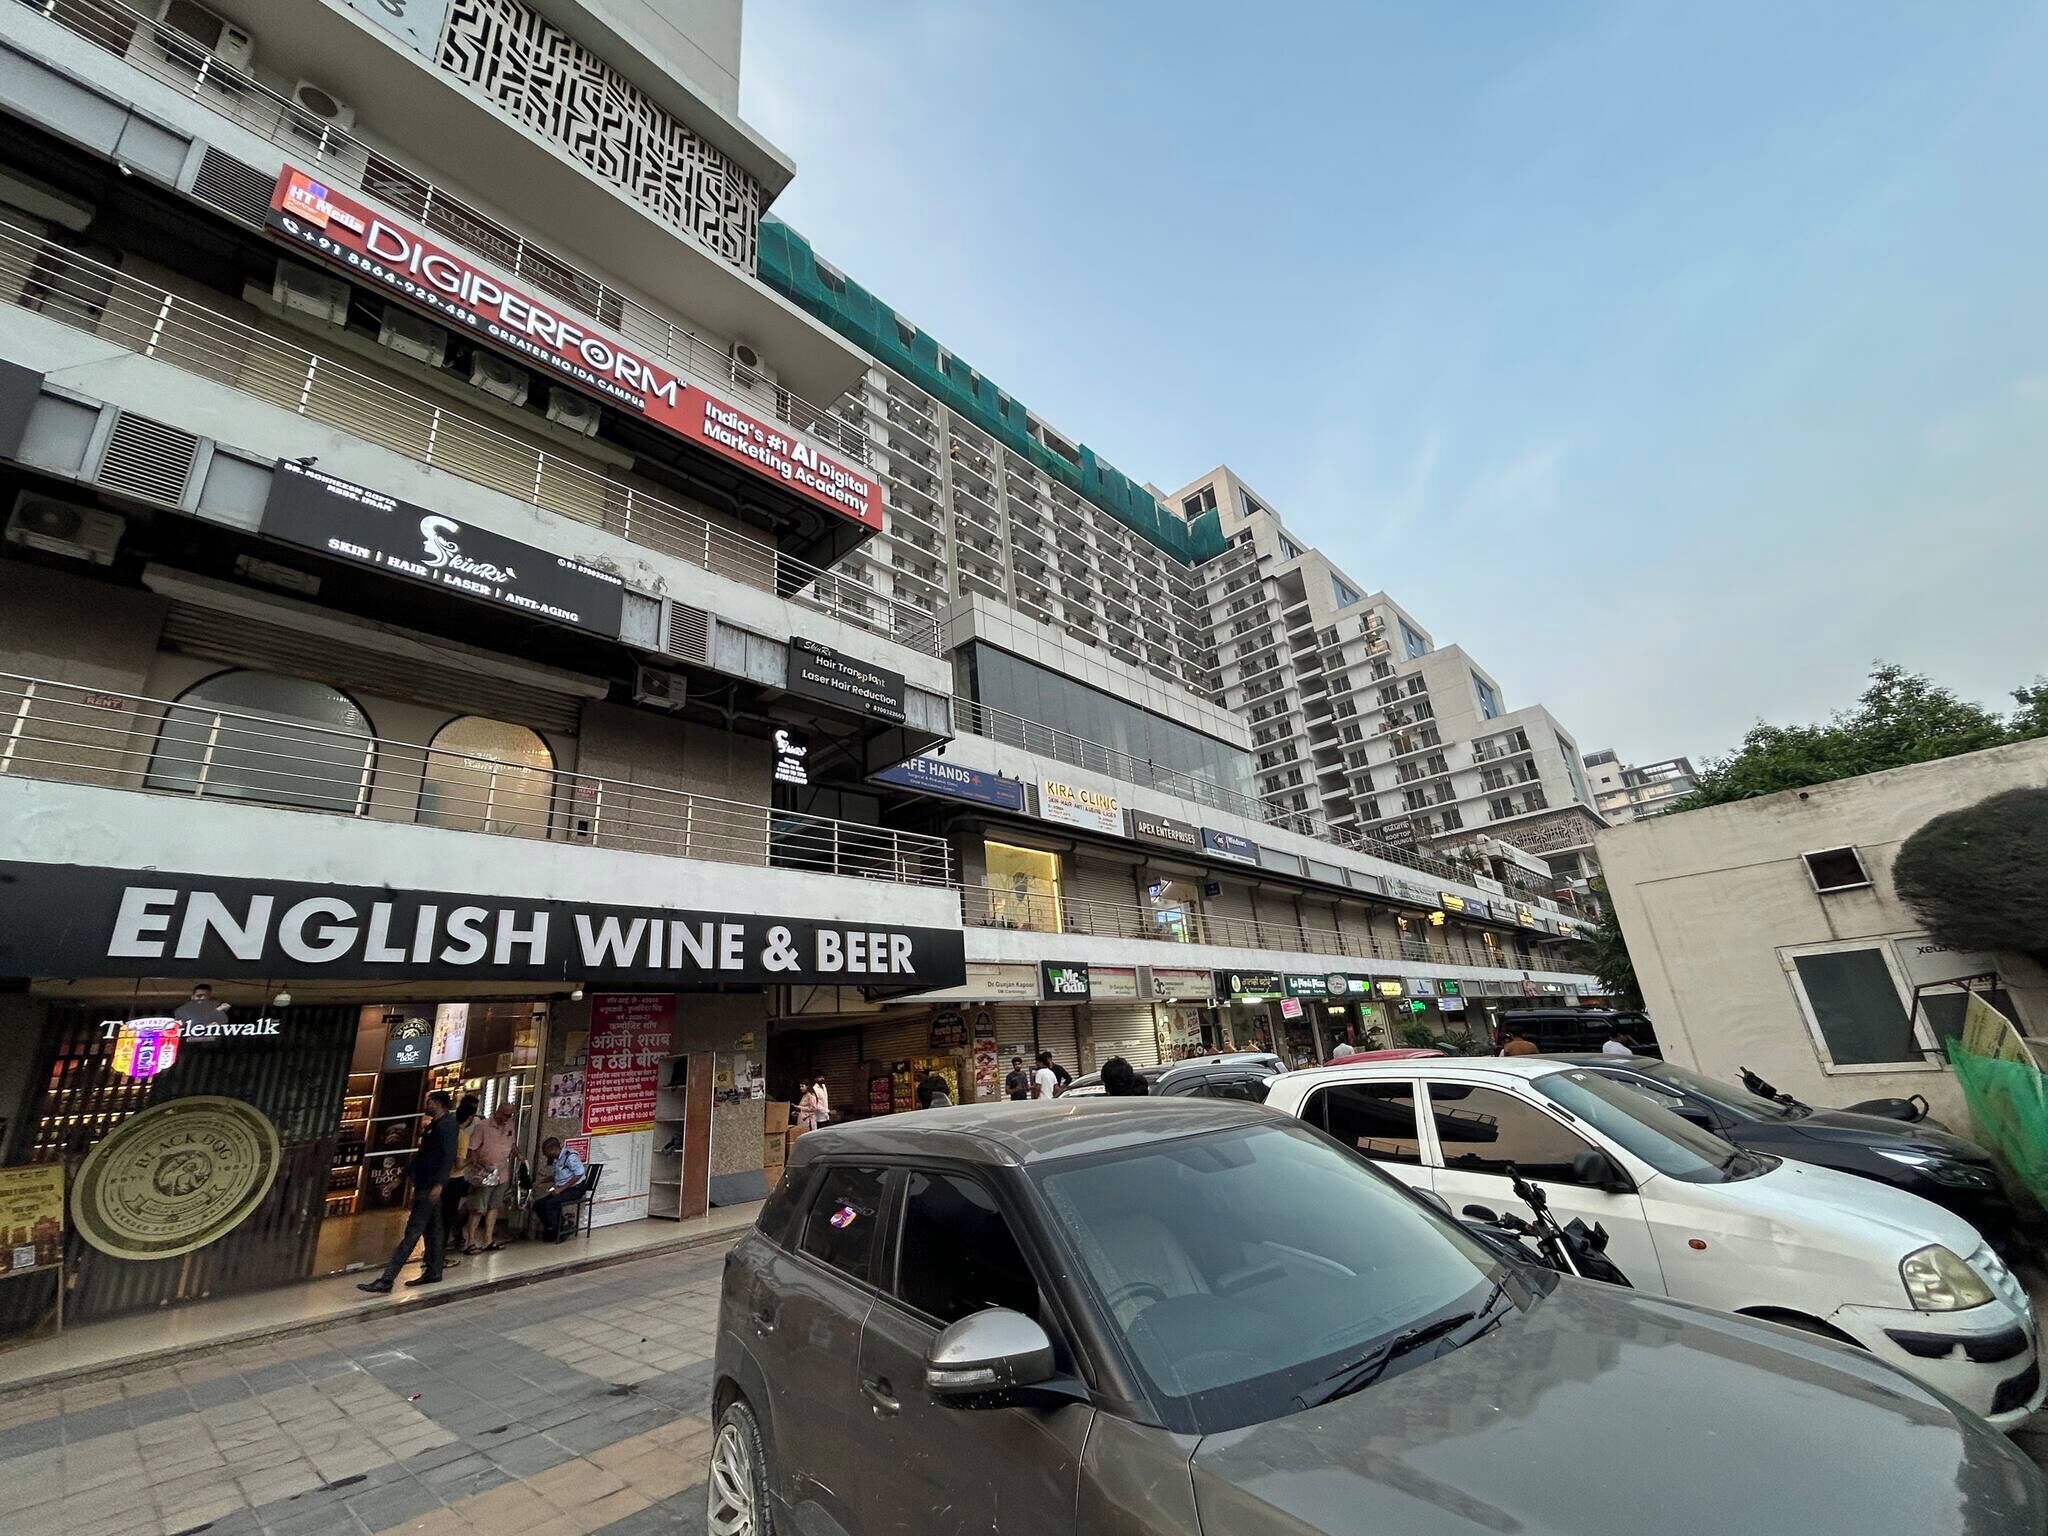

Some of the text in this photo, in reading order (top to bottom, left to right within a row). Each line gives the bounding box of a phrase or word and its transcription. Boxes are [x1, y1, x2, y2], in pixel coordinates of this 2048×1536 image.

[289, 184, 316, 206] HT
[302, 231, 342, 256] +91
[348, 252, 477, 325] 8864-929-488
[366, 218, 678, 408] DIGIPERFORM
[488, 324, 549, 361] GREATER
[597, 379, 646, 410] CAMPUS
[705, 401, 868, 498] India's #1 AI Digital
[703, 419, 869, 517] Marketing Academy
[328, 537, 579, 623] SKIN HAIR LASER ANTI-AGING
[801, 669, 897, 707] Laser Hair Reduction
[815, 655, 886, 688] Hair Transplant
[897, 758, 970, 784] AFE HANDS
[1047, 781, 1118, 811] KIRA CLINIC
[1138, 821, 1196, 846] APEX ENTERPRISES
[106, 886, 917, 975] ENGLISH WINE & BEER
[1054, 976, 1087, 993] Paan
[592, 1030, 672, 1049] अंग्रेजी शराब
[607, 1048, 634, 1070] ठंडी
[134, 1132, 197, 1169] BLACK
[203, 1133, 233, 1162] DOG
[371, 1166, 403, 1178] BLACK
